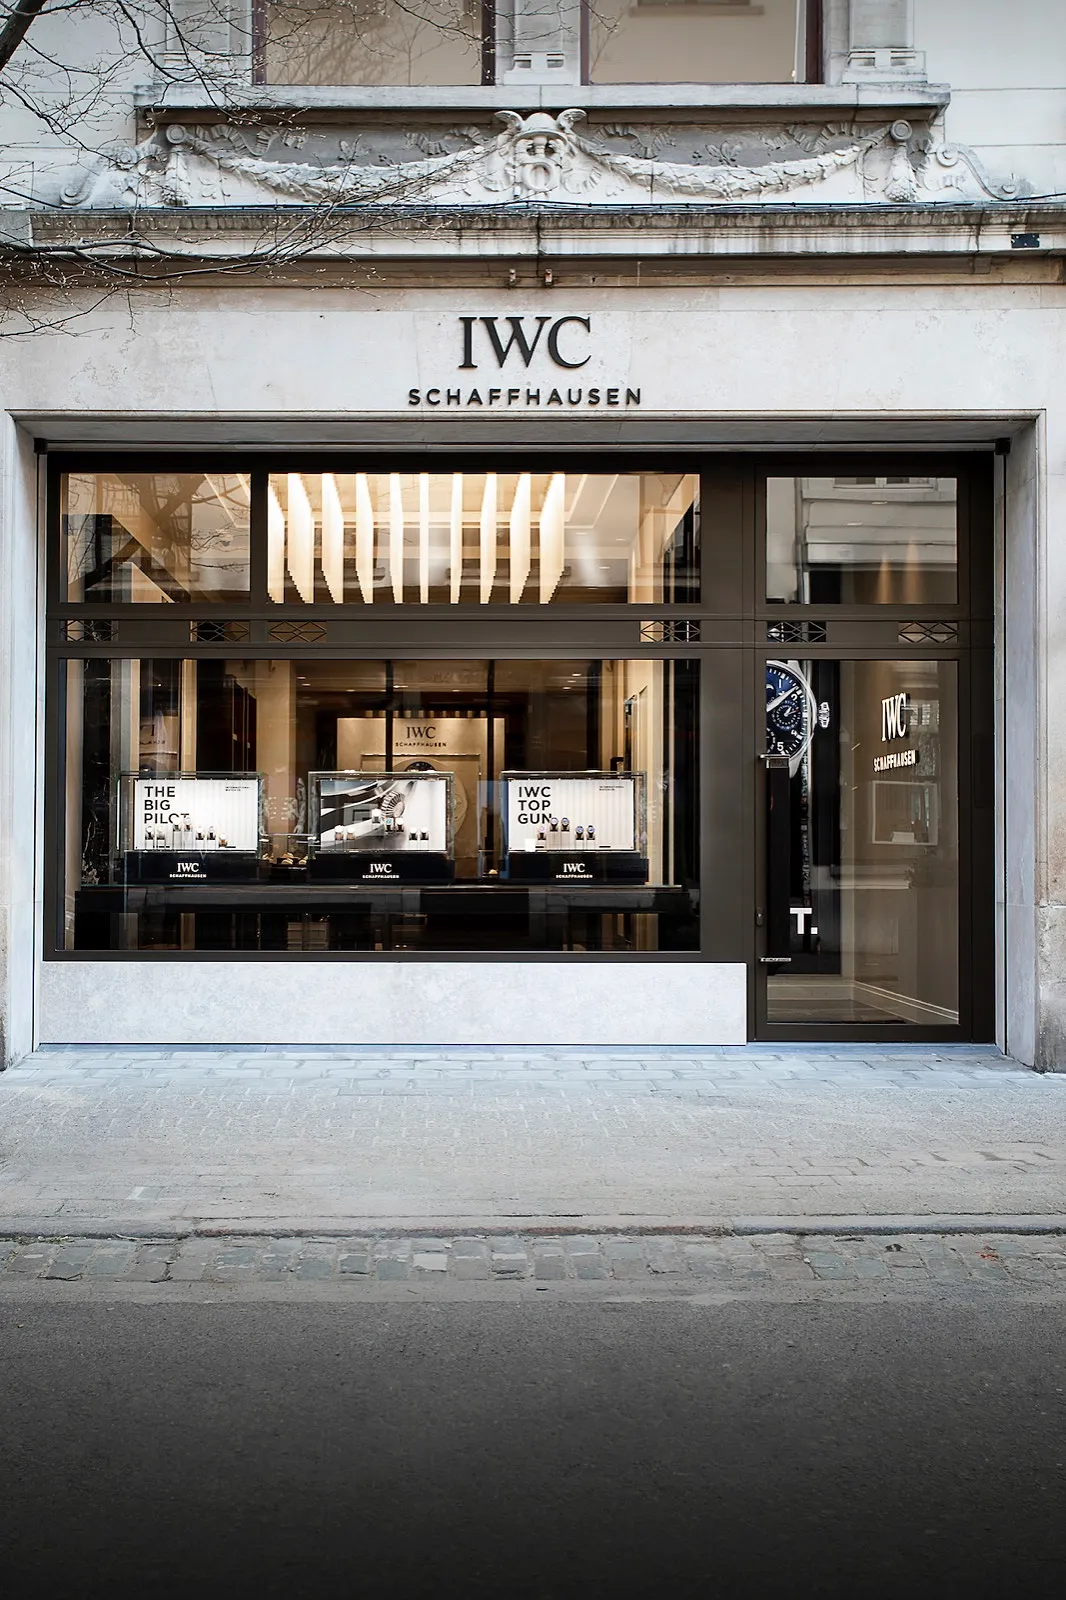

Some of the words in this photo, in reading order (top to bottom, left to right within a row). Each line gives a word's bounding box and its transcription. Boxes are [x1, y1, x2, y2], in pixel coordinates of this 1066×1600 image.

[458, 315, 592, 369] IWC
[408, 388, 642, 406] SCHAFFHAUSEN
[881, 692, 907, 742] IWC
[406, 726, 436, 739] IWC
[873, 749, 916, 773] SCHAFFHAUSEN
[144, 786, 176, 798] THE
[518, 786, 551, 798] IWC
[144, 799, 171, 811] BIG
[517, 799, 551, 811] TOP
[517, 813, 552, 825] GUN
[177, 862, 200, 873] IWC
[370, 863, 393, 874] IWC
[563, 863, 586, 873] IWC
